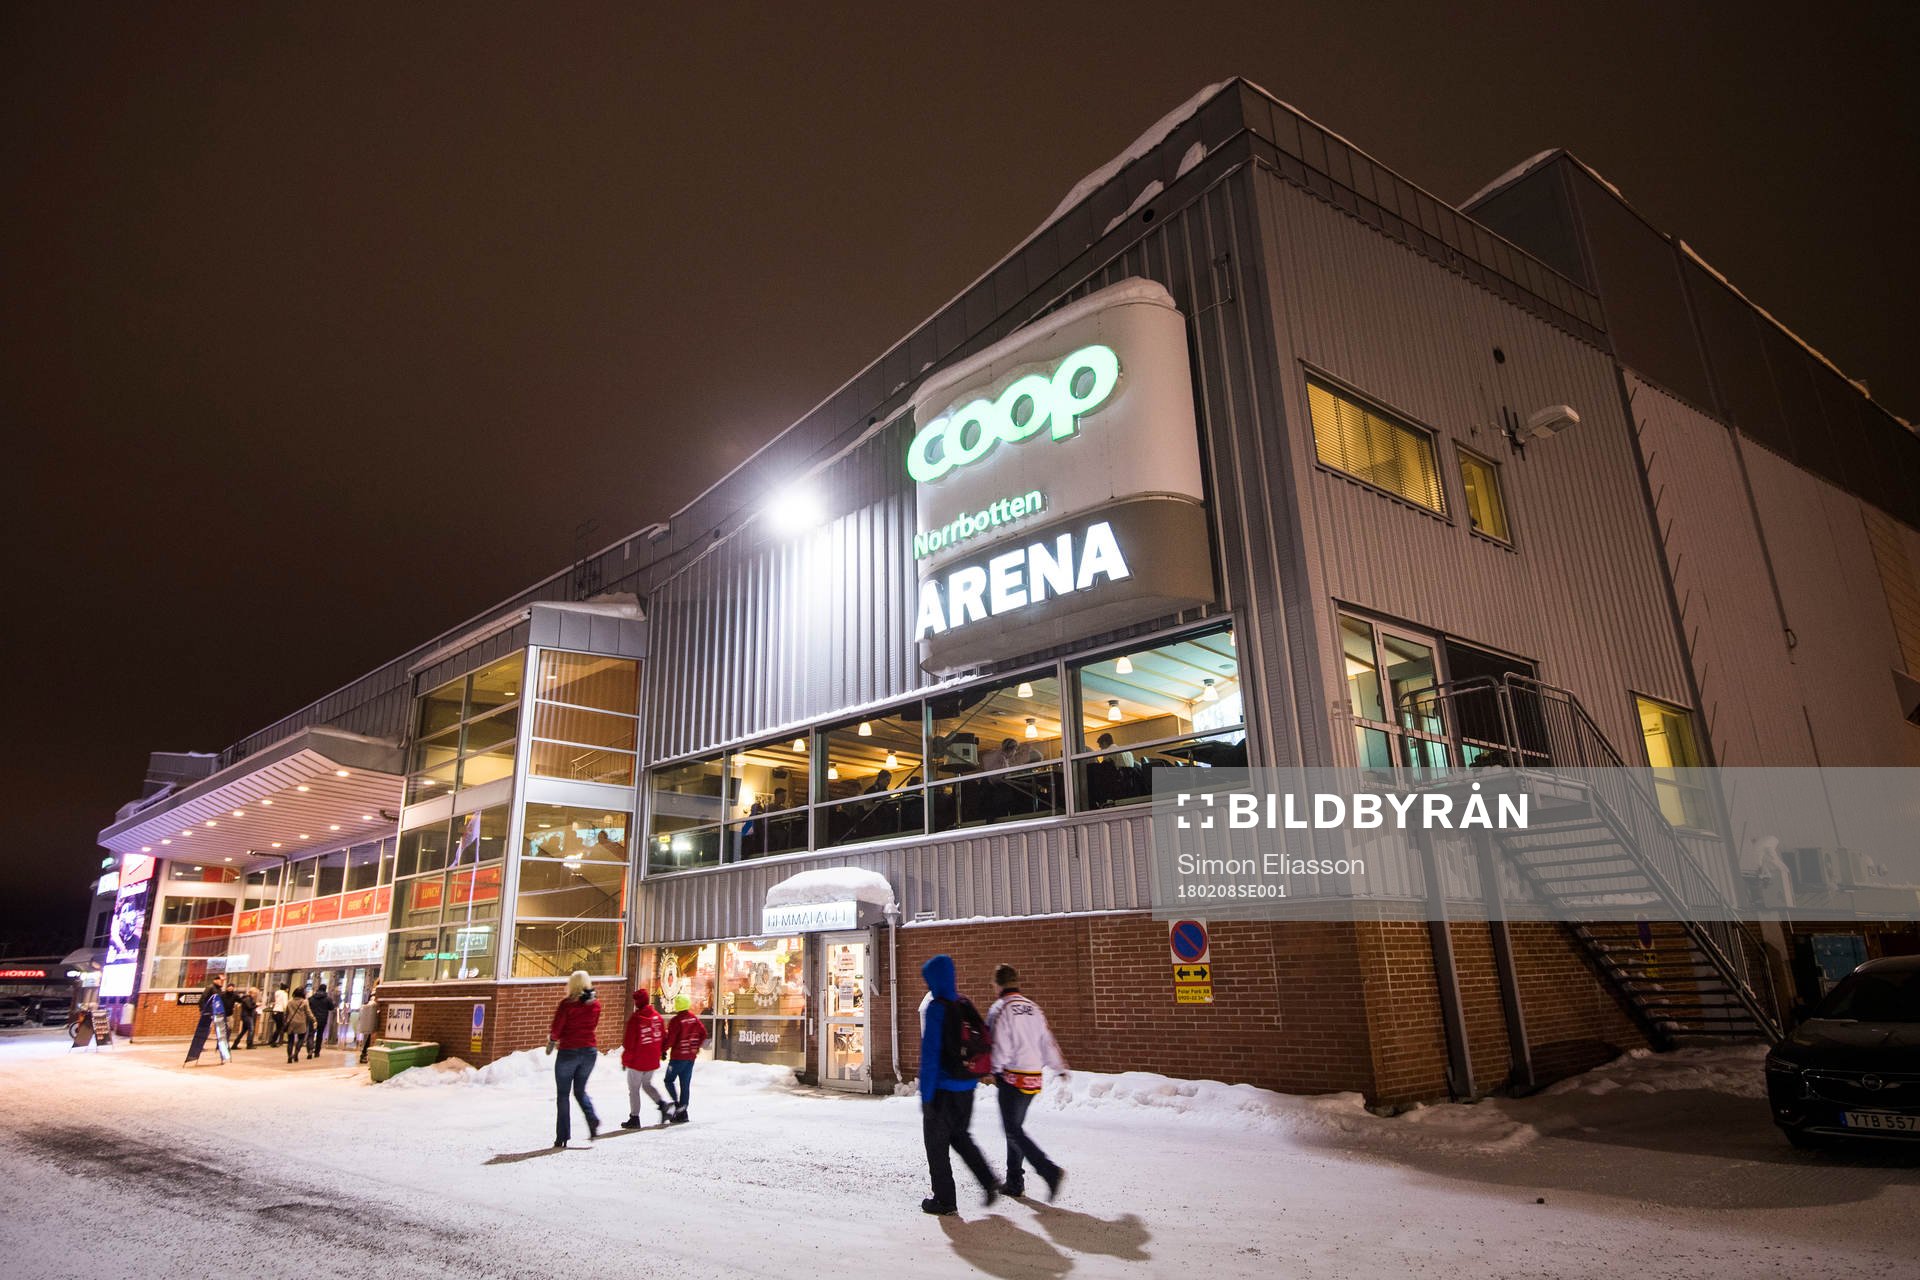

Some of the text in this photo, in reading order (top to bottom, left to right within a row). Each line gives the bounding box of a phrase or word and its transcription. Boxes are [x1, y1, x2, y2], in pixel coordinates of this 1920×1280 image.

[907, 345, 1118, 482] coop
[914, 490, 1043, 560] Norrbotten
[915, 521, 1130, 643] ARENA
[421, 886, 440, 899] LUNCH
[388, 1008, 412, 1019] BILJETTER
[738, 1030, 781, 1045] Biljetter
[1851, 1114, 1915, 1130] YTB 557
